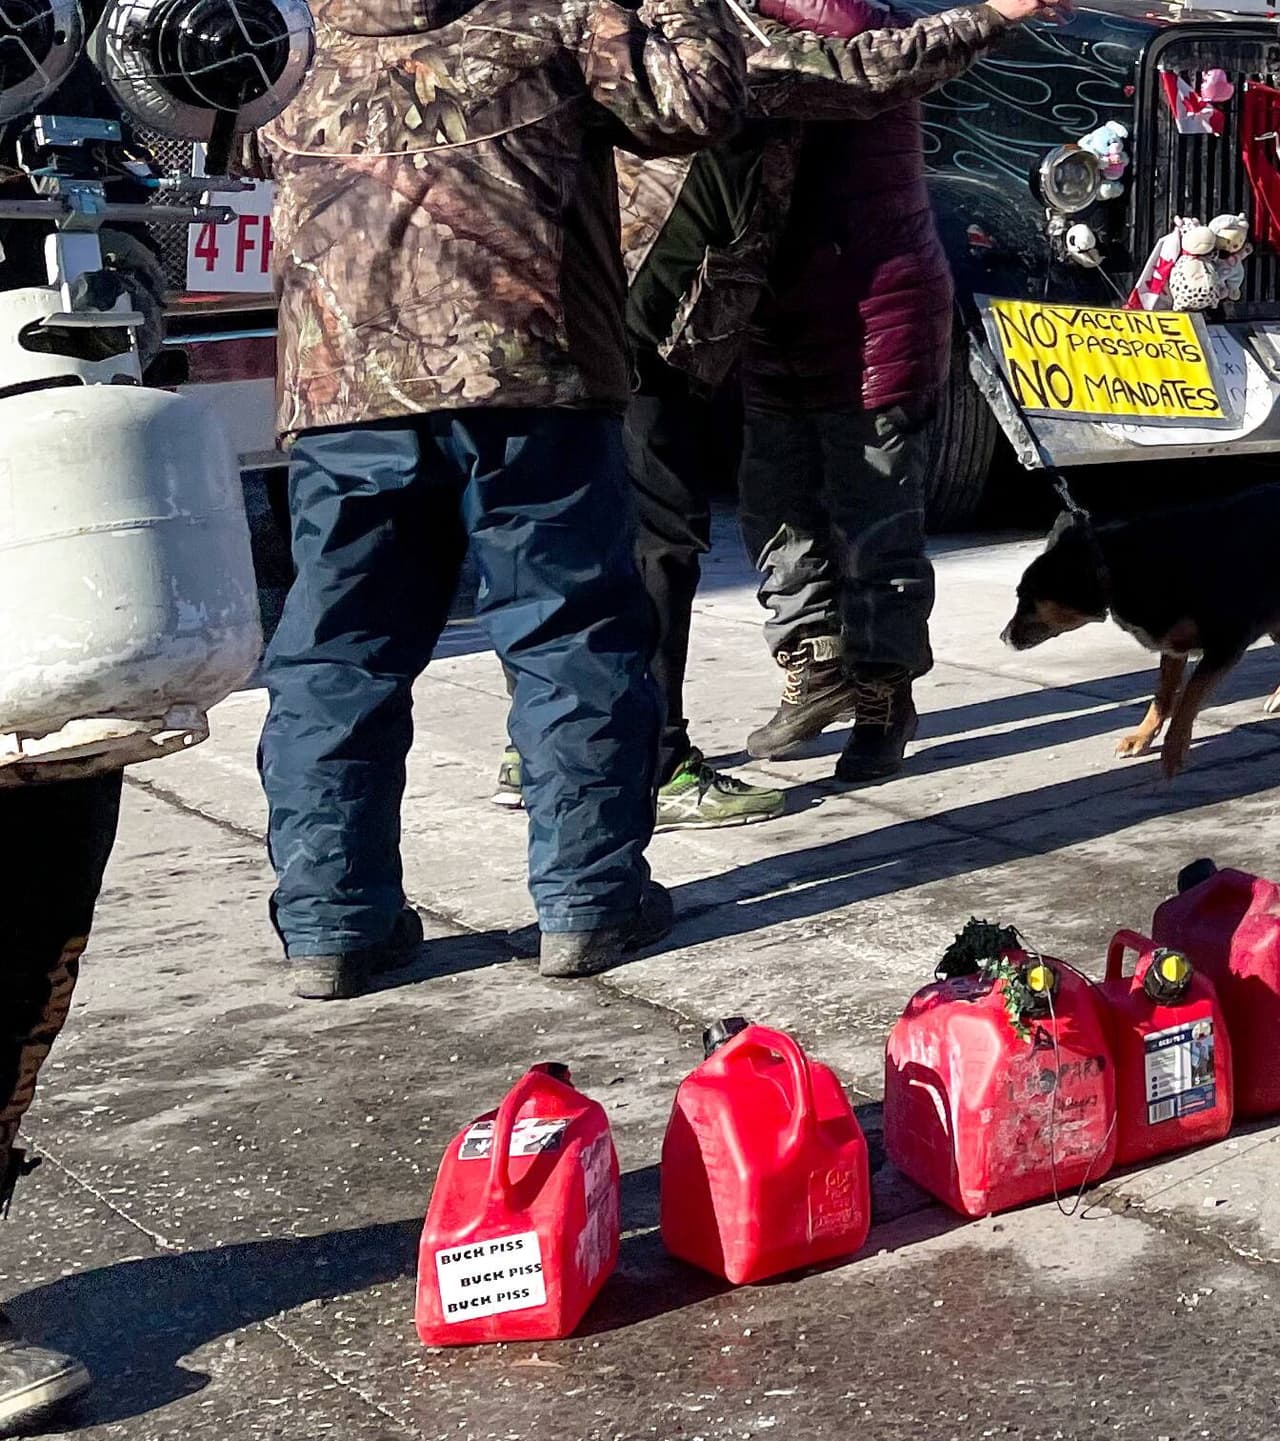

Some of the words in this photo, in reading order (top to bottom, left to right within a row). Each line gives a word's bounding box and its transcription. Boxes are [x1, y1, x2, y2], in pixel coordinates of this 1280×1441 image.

[998, 308, 1058, 349] NO
[1054, 308, 1182, 337] VACCINE
[1066, 333, 1203, 363] PASSPORTS
[1008, 359, 1074, 409] NO
[1084, 373, 1220, 411] MANDATES
[490, 1239, 524, 1255] PISS
[509, 1262, 543, 1278] PISS
[497, 1288, 530, 1303] PISS
